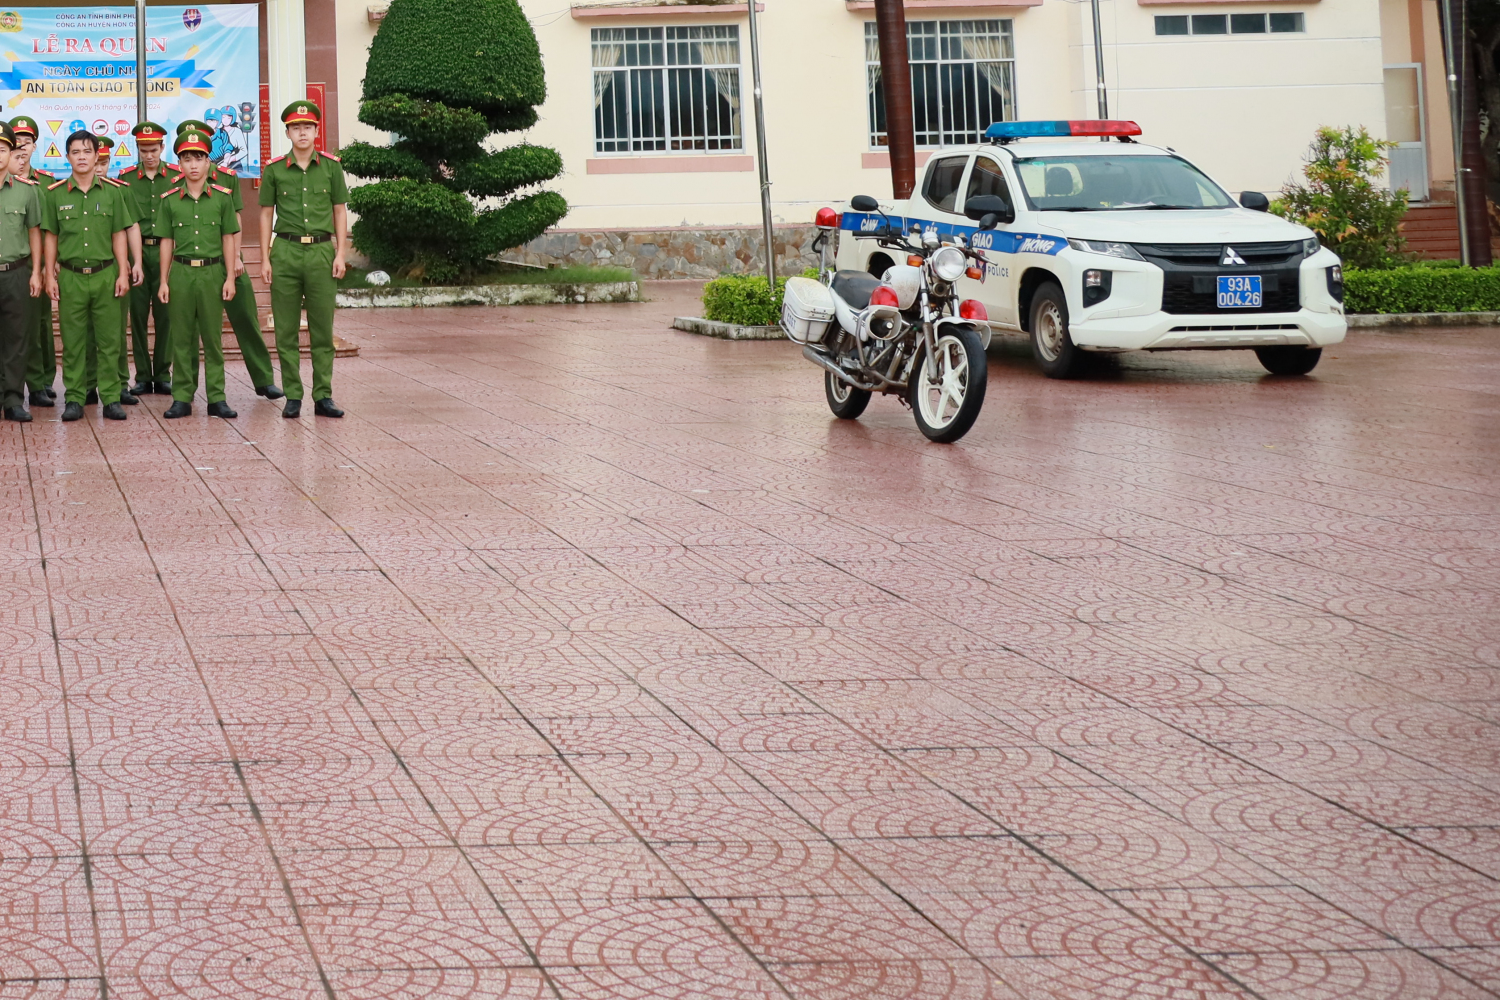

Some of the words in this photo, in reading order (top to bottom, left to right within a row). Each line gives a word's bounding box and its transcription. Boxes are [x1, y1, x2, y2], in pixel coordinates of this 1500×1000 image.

[32, 33, 60, 54] LỄ
[65, 37, 96, 54] RA
[43, 64, 82, 76] NGÀY
[118, 65, 155, 77] NHT
[26, 82, 45, 94] AN
[49, 79, 85, 93] TOÀN
[89, 81, 123, 93] GIAO
[115, 123, 130, 132] STOP
[972, 232, 993, 249] GIAO
[1021, 234, 1056, 254] THÔNG
[987, 266, 1009, 278] POLICE
[1227, 277, 1252, 292] 93A
[1219, 291, 1260, 306] 004.26
